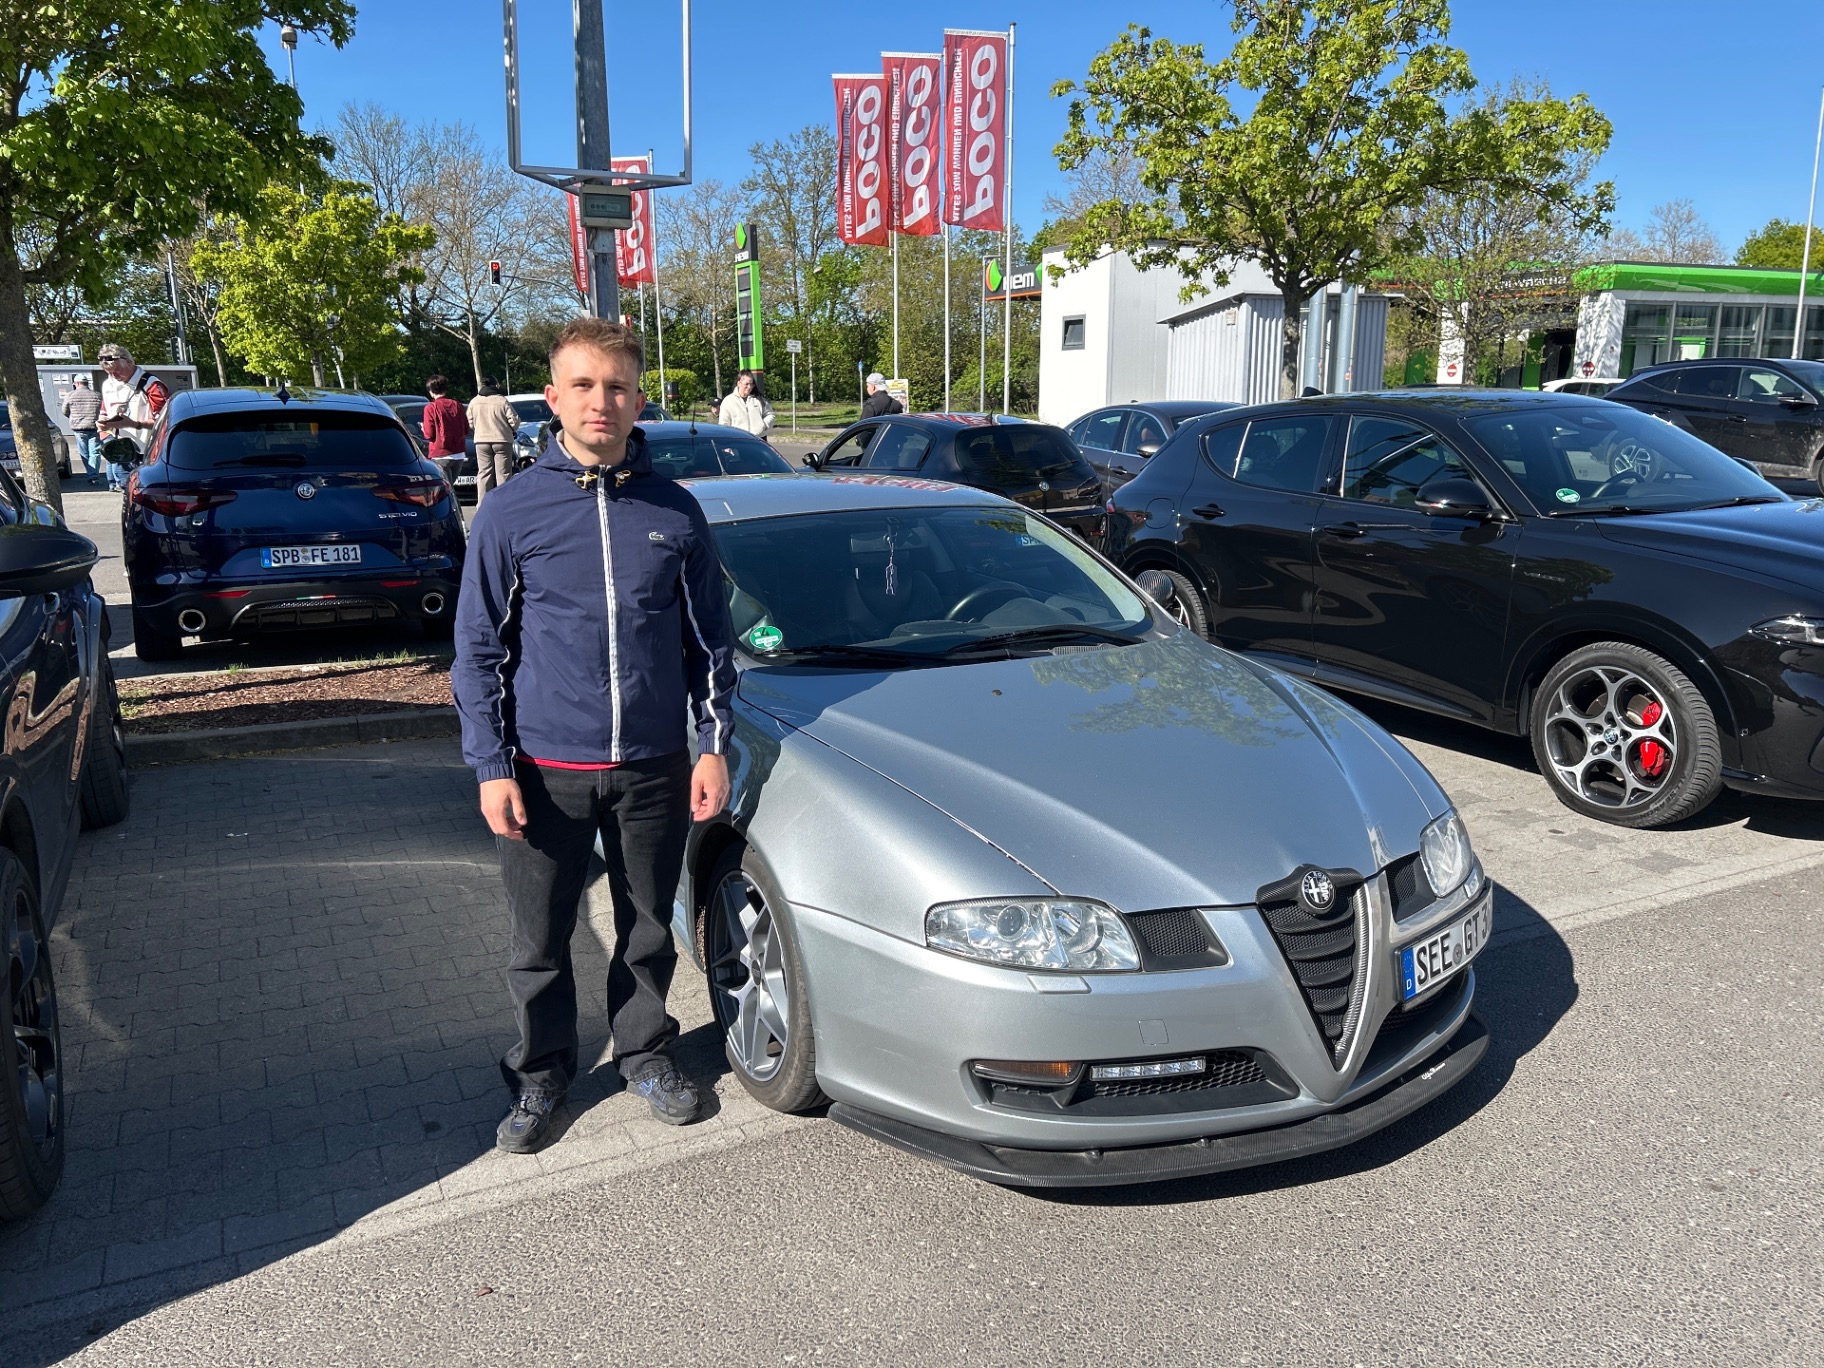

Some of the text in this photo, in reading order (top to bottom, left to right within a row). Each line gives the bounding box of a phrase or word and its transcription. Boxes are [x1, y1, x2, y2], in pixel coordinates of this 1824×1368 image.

[272, 548, 300, 564] SPB
[310, 547, 330, 563] FE
[332, 546, 360, 562] 181
[1406, 978, 1412, 991] D
[1416, 929, 1453, 986] SEE
[1462, 910, 1480, 957] GT
